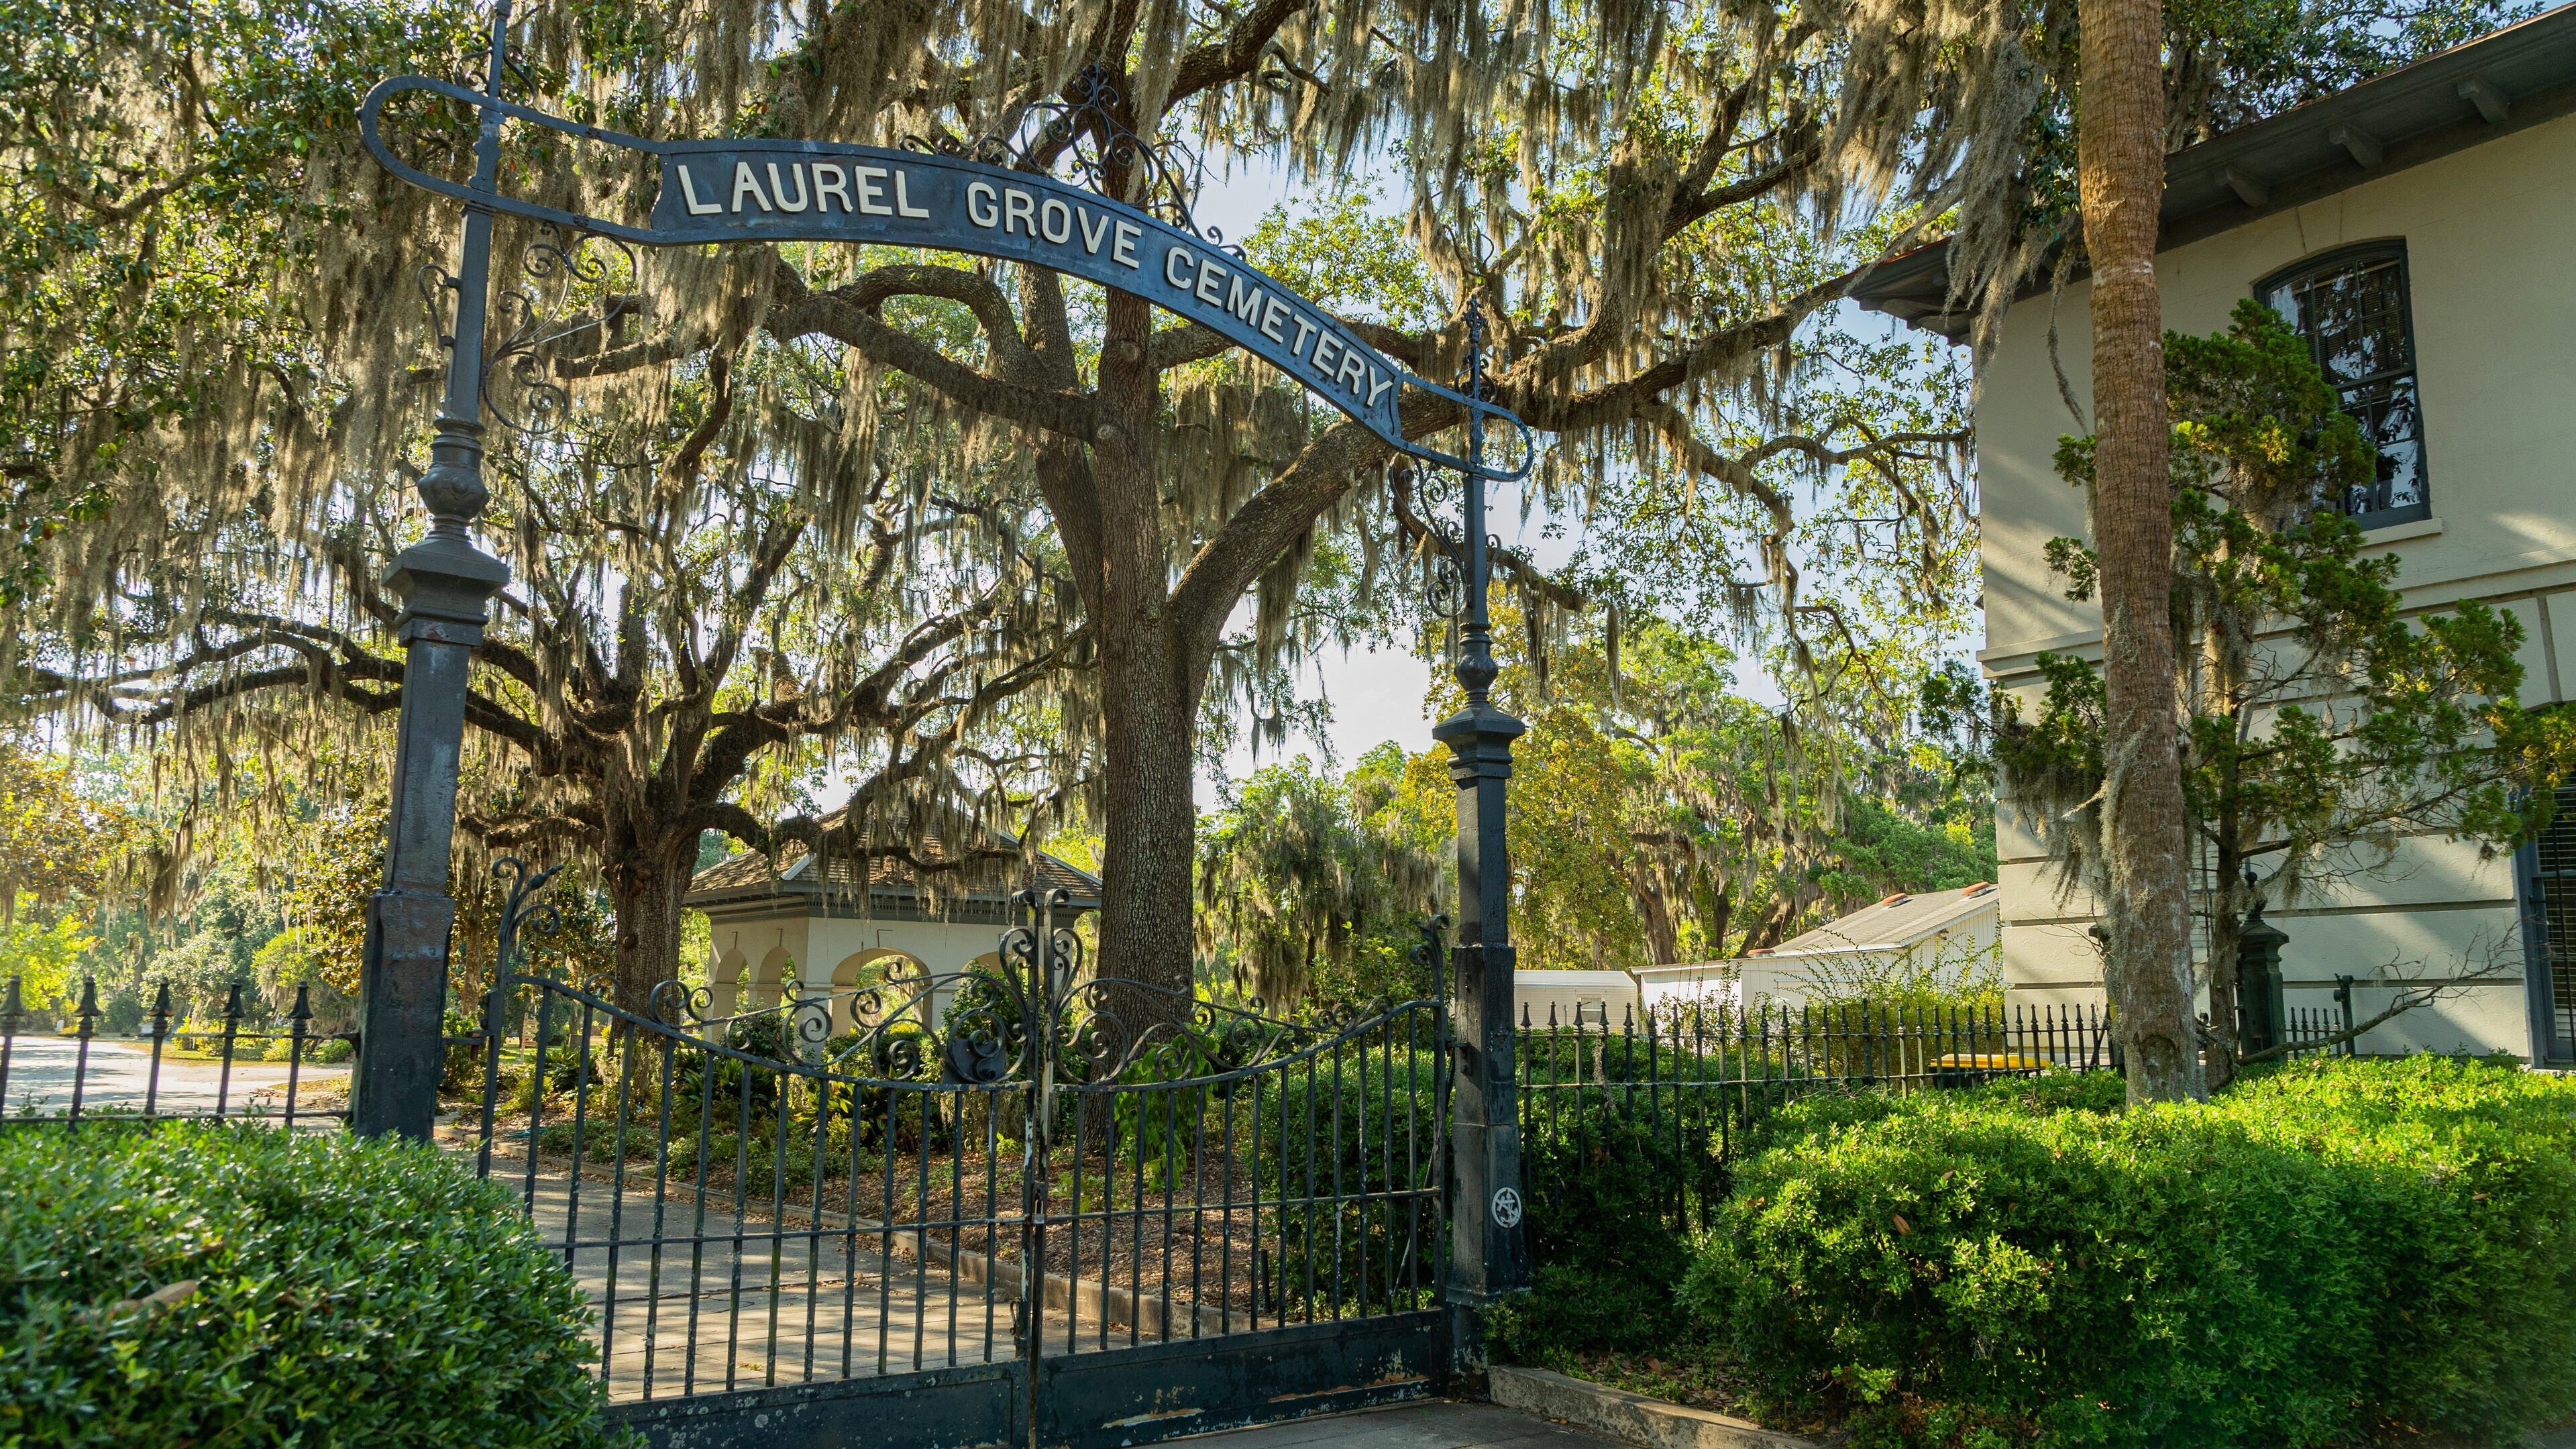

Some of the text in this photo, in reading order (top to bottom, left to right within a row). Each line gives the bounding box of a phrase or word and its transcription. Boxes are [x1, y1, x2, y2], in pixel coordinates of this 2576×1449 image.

[678, 162, 1393, 407] LAUREL GROVE CEMETERY
